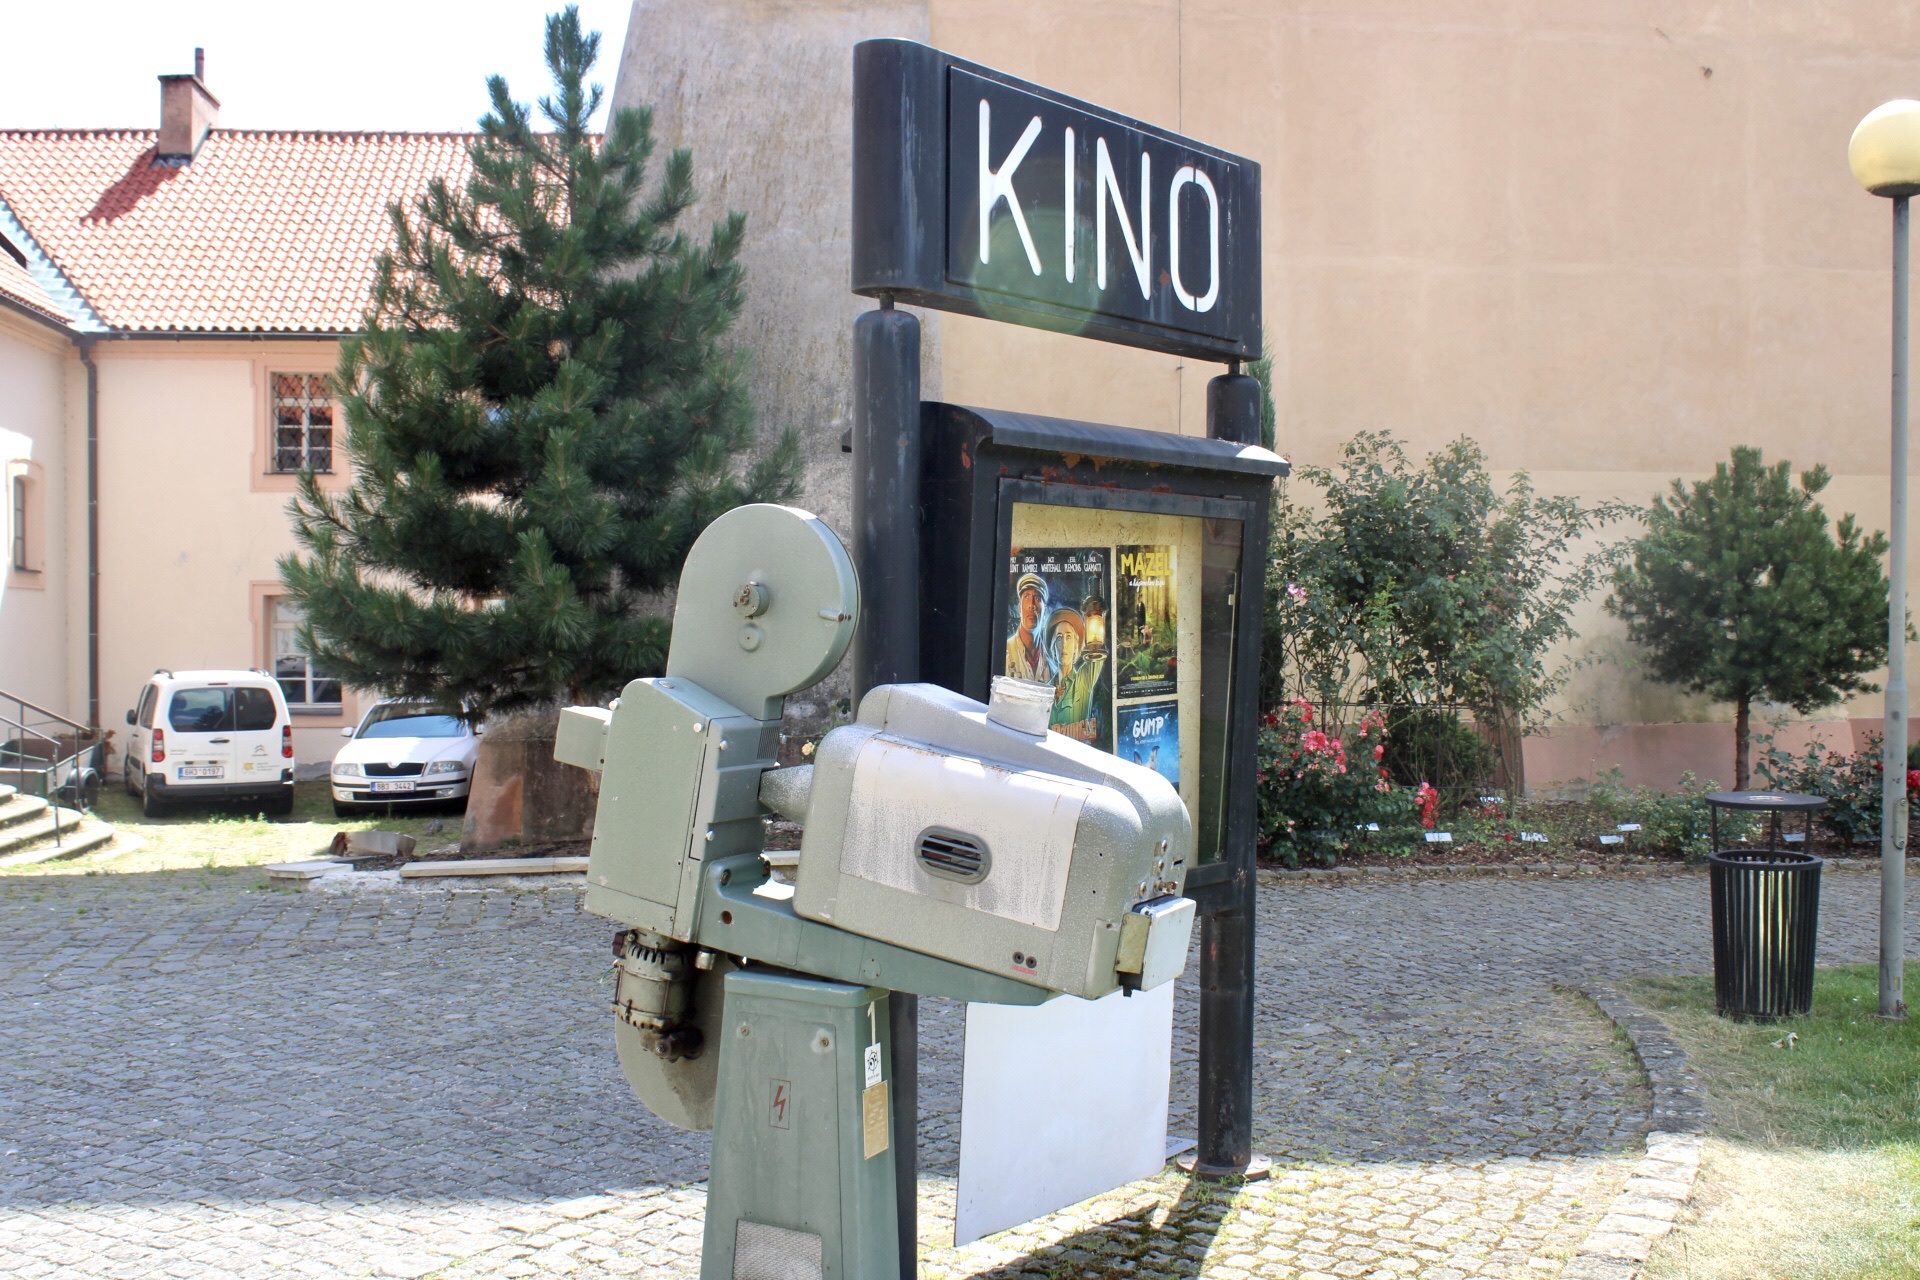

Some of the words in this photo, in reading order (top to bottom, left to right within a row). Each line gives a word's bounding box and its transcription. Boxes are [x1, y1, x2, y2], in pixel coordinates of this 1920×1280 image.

[979, 98, 1219, 313] KINO
[1121, 552, 1173, 576] MAZEL
[1133, 716, 1164, 738] GUMP
[202, 767, 220, 776] 0197
[394, 782, 412, 790] 3442
